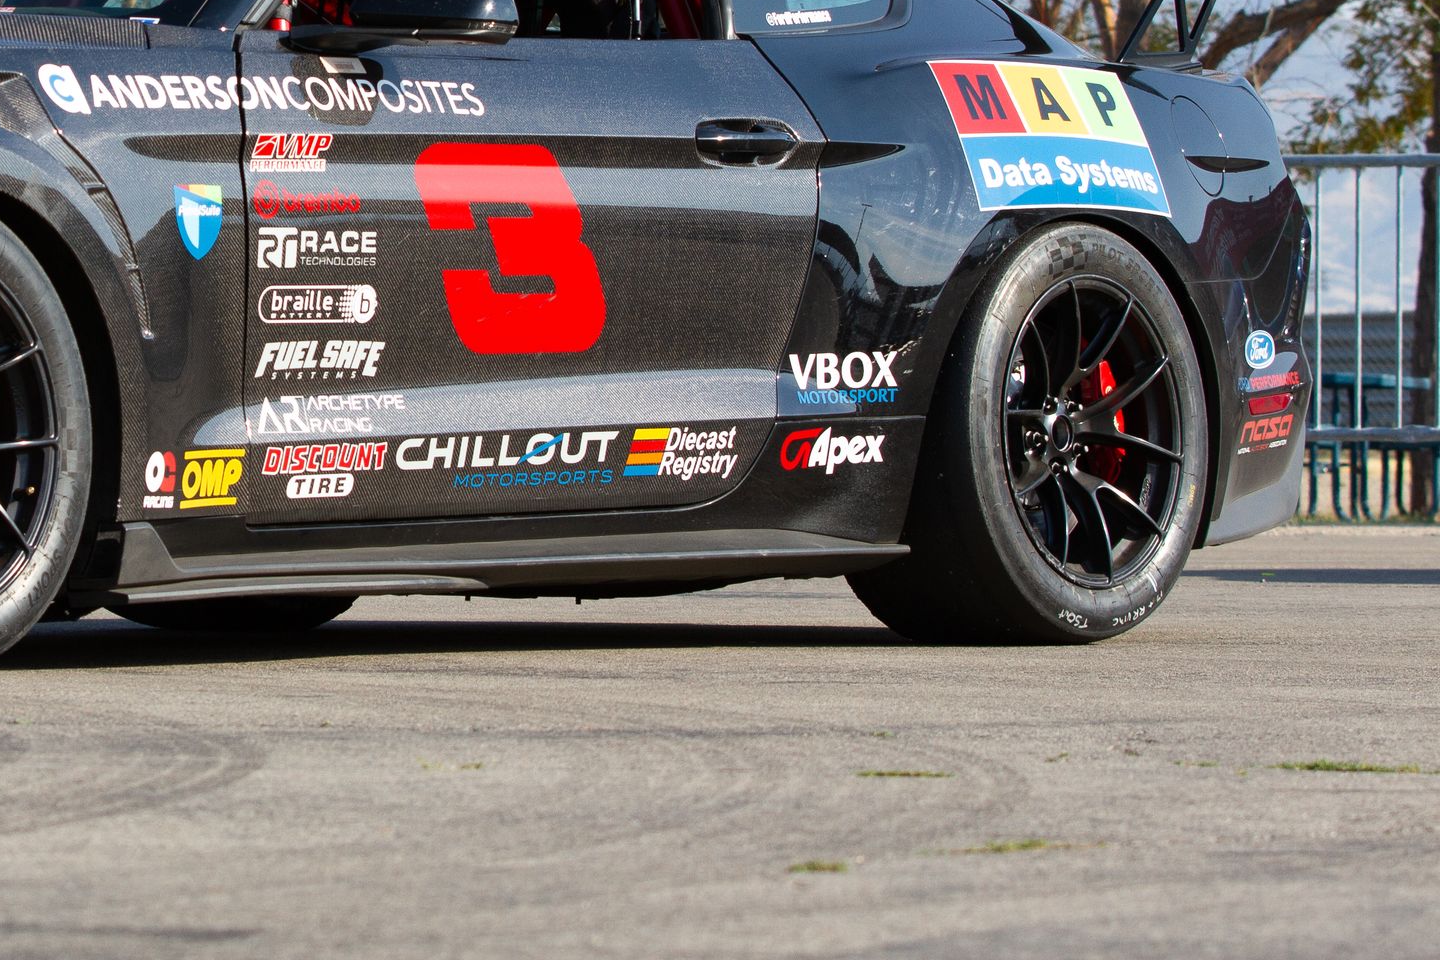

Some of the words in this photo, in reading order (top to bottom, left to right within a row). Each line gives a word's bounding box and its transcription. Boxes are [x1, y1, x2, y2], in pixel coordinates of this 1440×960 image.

[275, 133, 333, 159] VMP
[250, 159, 327, 172] PERFORMANCE
[978, 156, 1053, 189] Data
[1055, 155, 1159, 195] Systems
[282, 187, 361, 213] brembo
[300, 230, 378, 254] RACE
[414, 142, 607, 355] 3
[300, 256, 377, 267] TECHNOLOGIES
[271, 289, 333, 311] braille
[254, 341, 321, 378] FUEL
[320, 340, 386, 377] SAFE
[1250, 336, 1269, 361] Ford
[271, 371, 357, 380] SYSTEMS
[789, 351, 898, 390] VBOX
[307, 395, 406, 411] ARCHETYPE
[797, 388, 899, 404] MOTORSPORT
[310, 417, 373, 434] RACING
[395, 431, 620, 471] CHILLOUT
[665, 426, 737, 452] Diecast
[261, 442, 388, 476] DISCOUNT
[658, 452, 739, 481] Registry
[181, 458, 243, 499] OMP
[296, 477, 346, 495] TIRE
[453, 469, 614, 488] MOTORSPORTS
[143, 495, 175, 509] RACING
